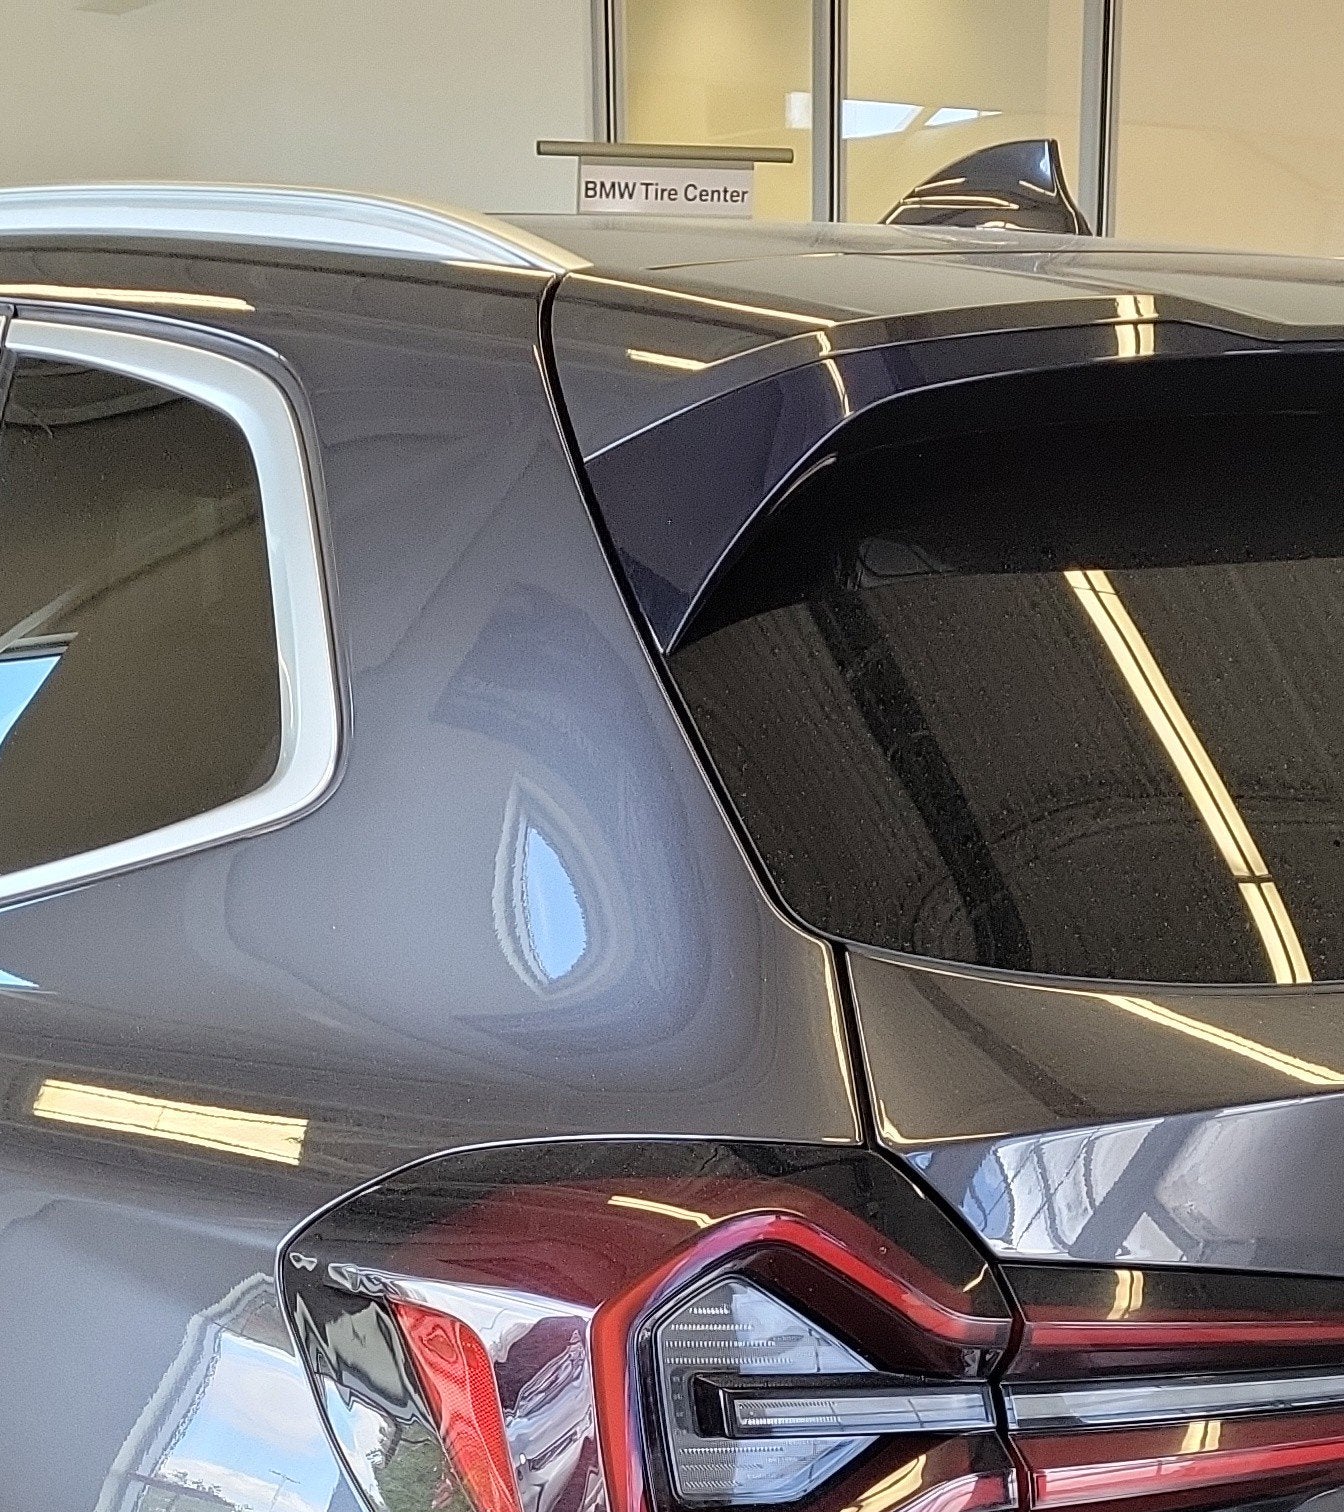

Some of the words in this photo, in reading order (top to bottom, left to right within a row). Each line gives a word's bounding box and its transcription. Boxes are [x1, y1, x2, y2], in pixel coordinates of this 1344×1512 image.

[584, 180, 636, 200] BMW
[640, 182, 678, 201] Tire
[683, 183, 748, 203] Center
